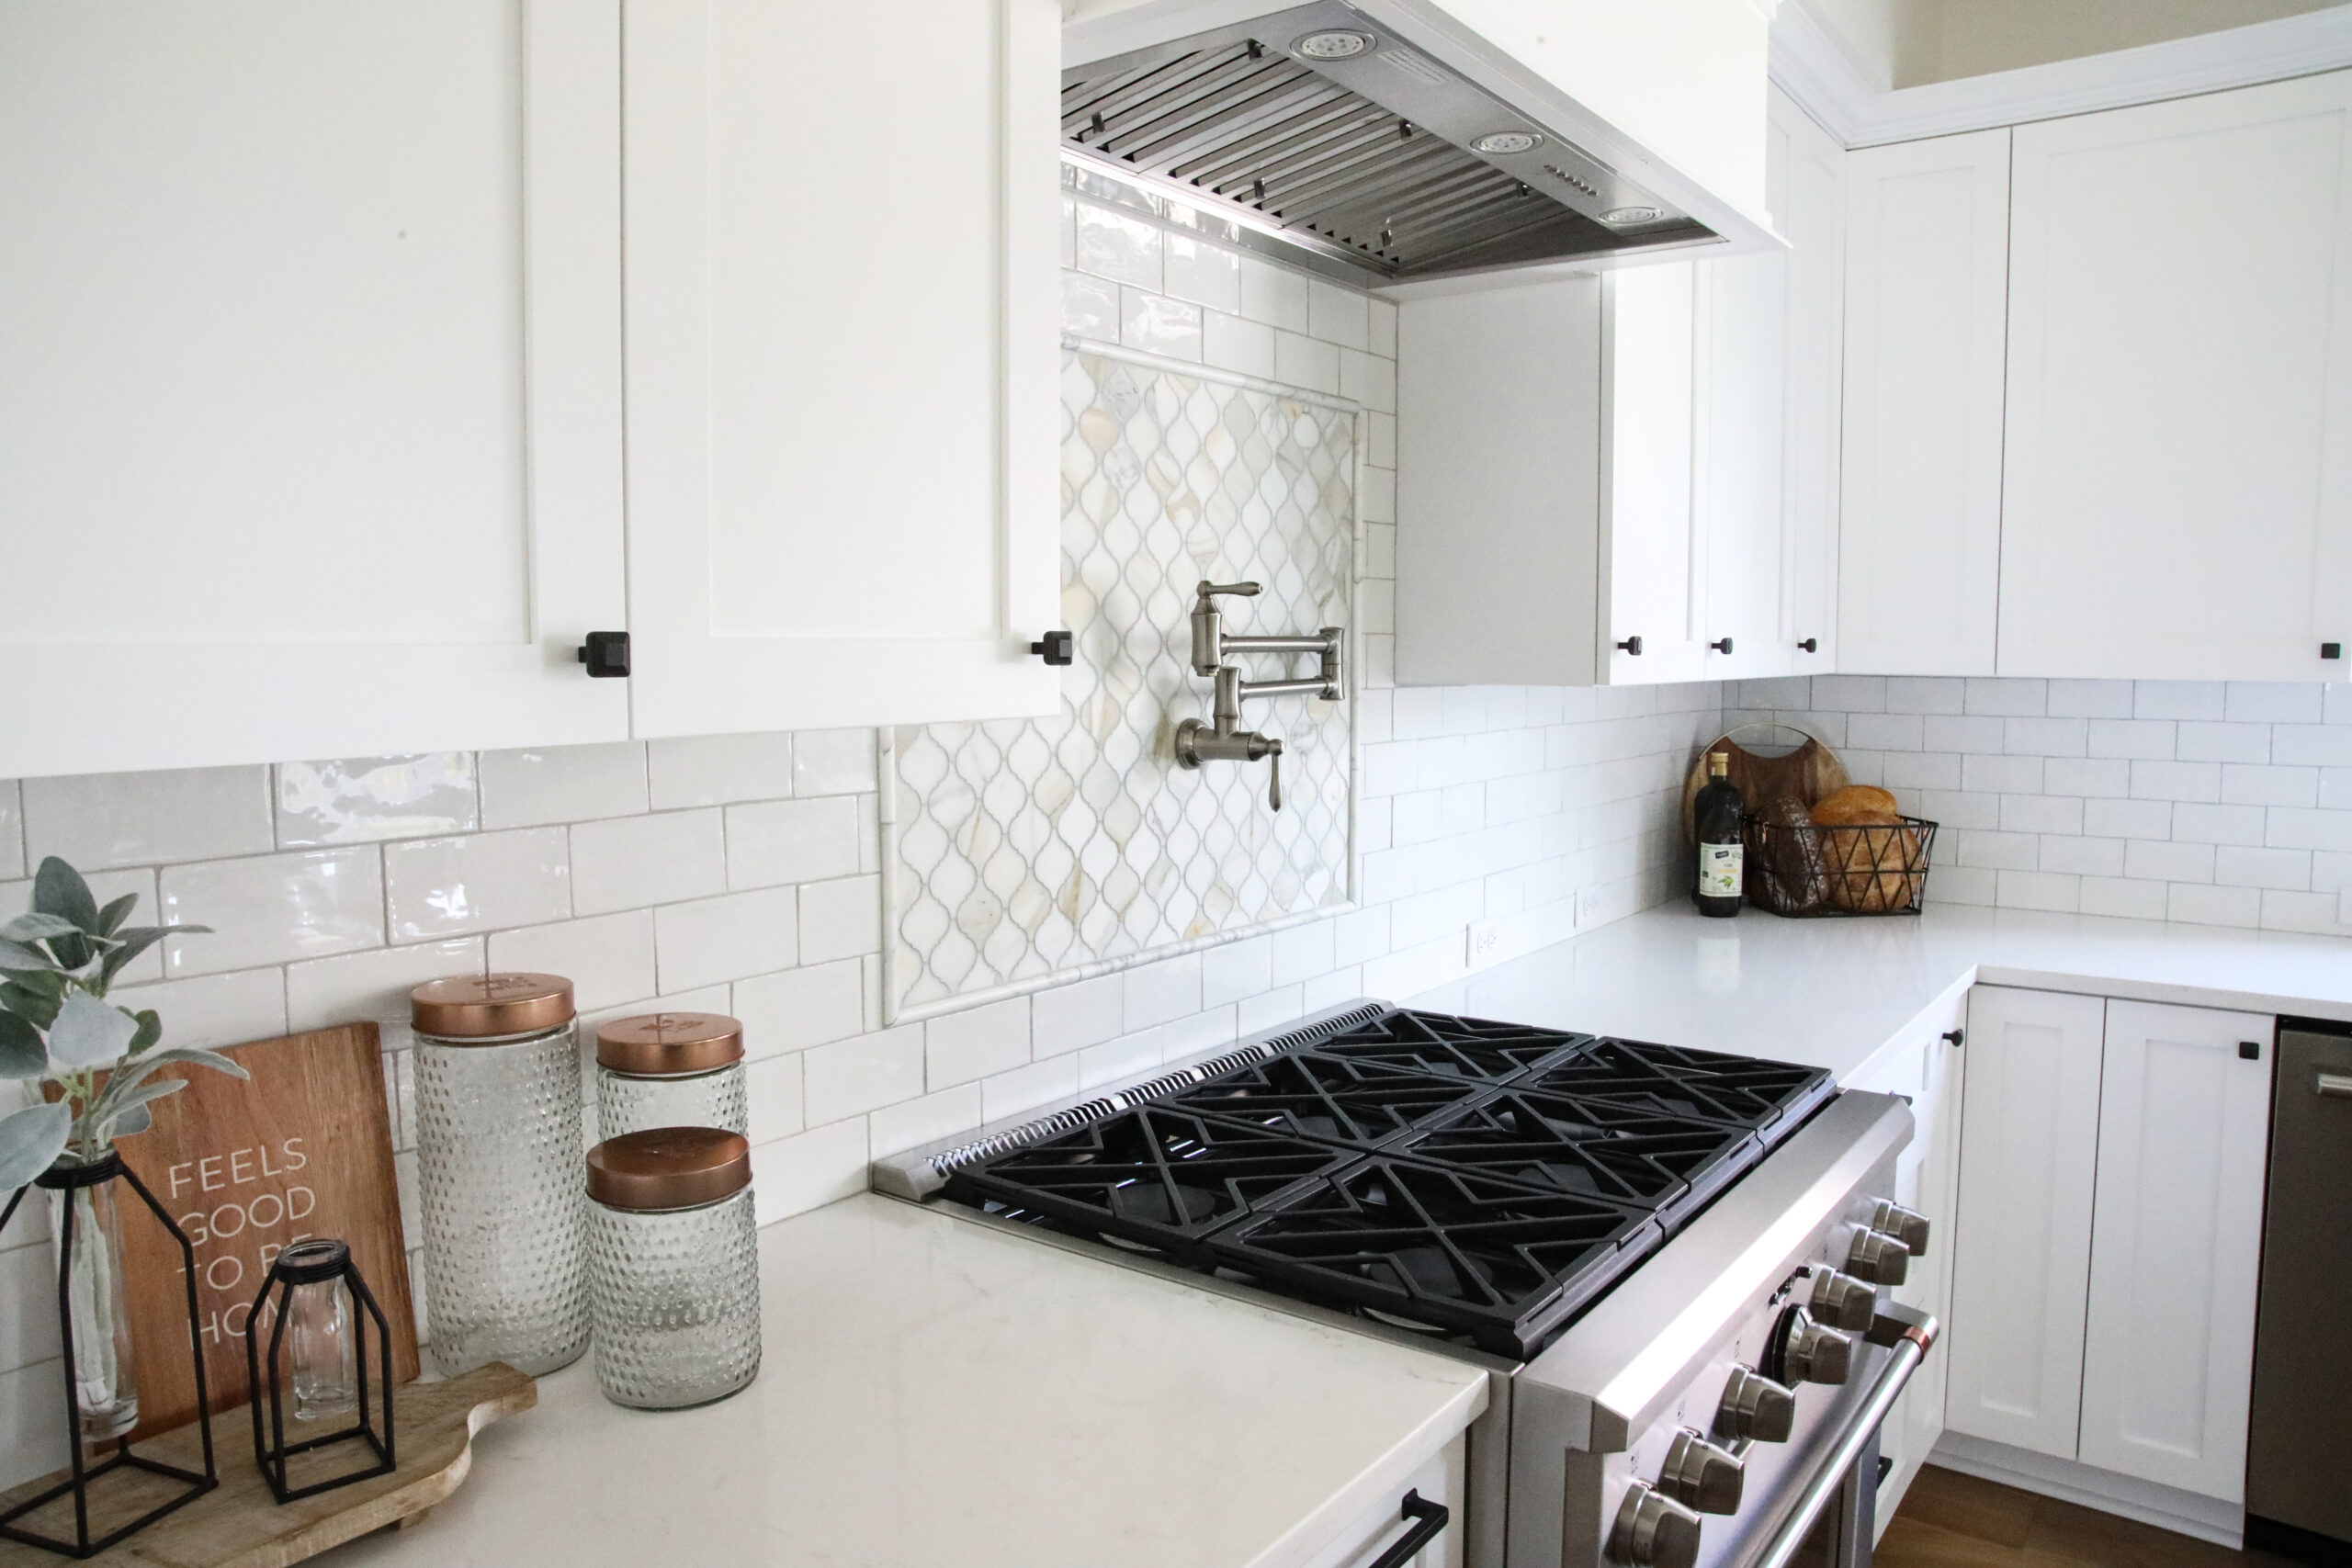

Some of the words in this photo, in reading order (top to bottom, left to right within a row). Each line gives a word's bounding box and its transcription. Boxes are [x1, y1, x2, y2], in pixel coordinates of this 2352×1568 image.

[169, 1138, 307, 1199] FEELS
[177, 1186, 315, 1247] GOOD
[187, 1295, 291, 1351] HOM
